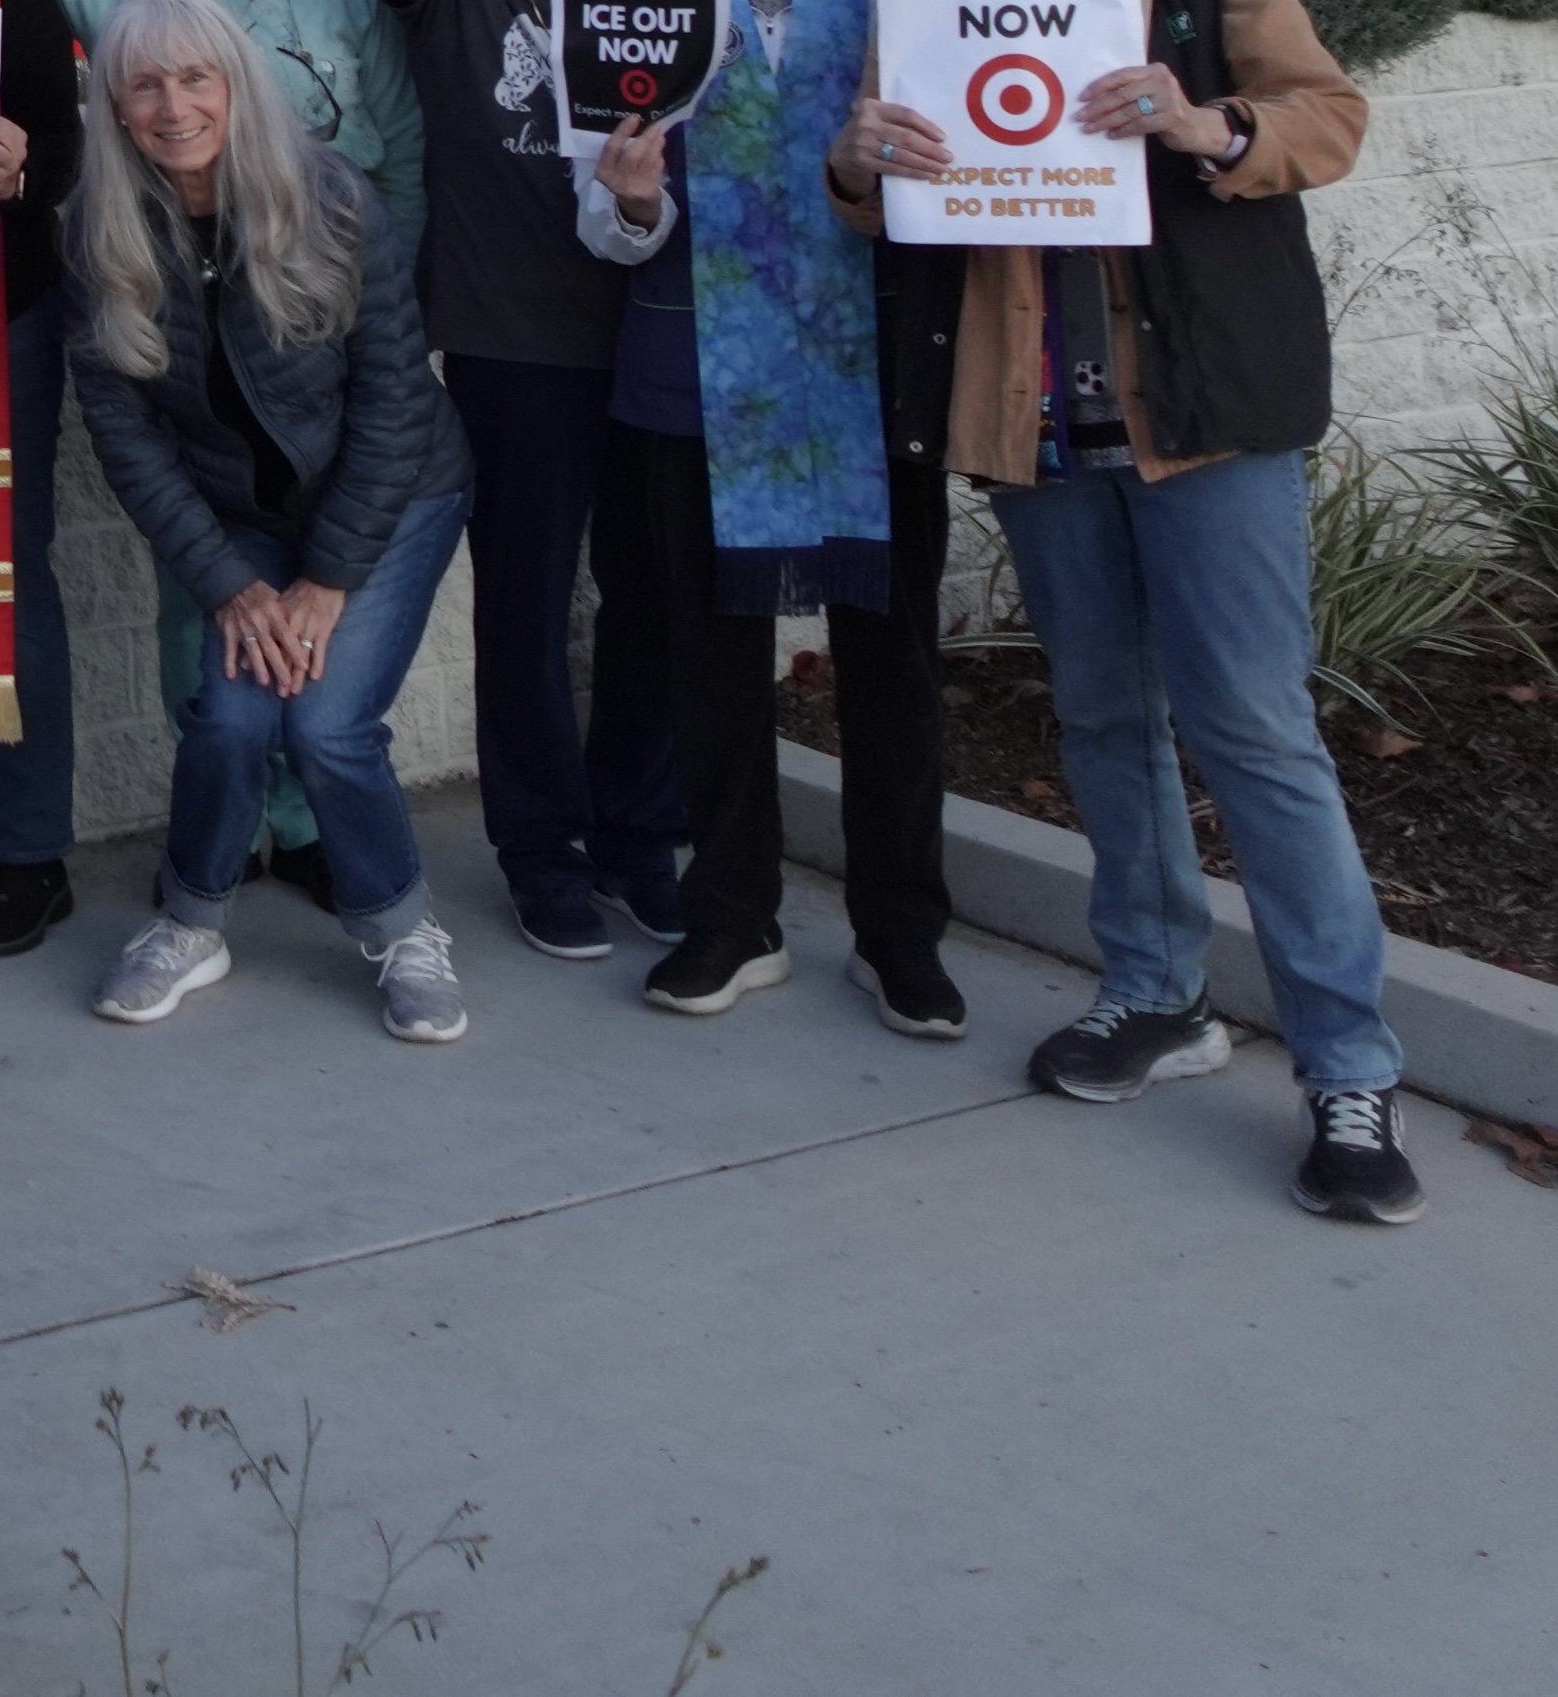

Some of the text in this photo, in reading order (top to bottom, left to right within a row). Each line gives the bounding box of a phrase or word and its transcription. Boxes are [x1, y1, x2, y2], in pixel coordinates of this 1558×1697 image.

[583, 4, 696, 34] ICE OUT
[958, 4, 1076, 38] NOW
[598, 36, 679, 65] NOW
[574, 103, 612, 117] Expect
[929, 167, 1117, 186] EXPECT MORE
[945, 198, 1095, 217] DO BETTER
